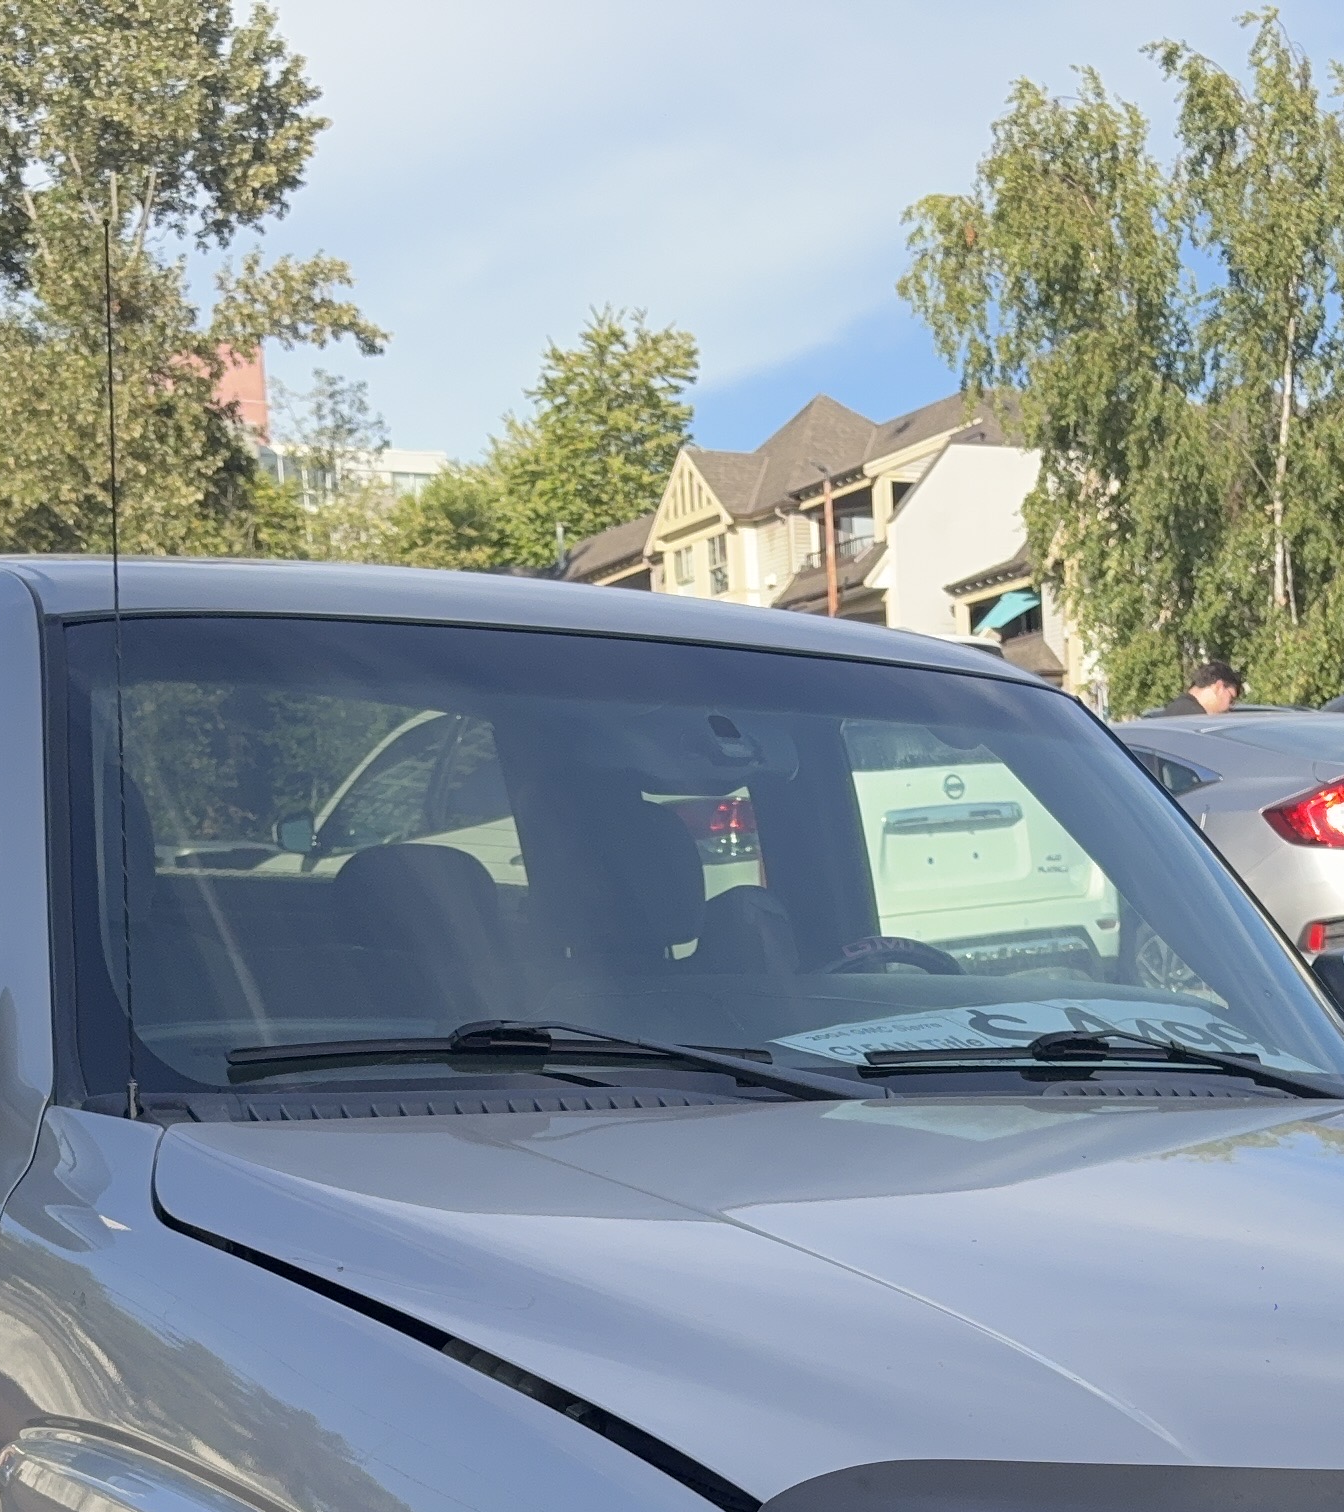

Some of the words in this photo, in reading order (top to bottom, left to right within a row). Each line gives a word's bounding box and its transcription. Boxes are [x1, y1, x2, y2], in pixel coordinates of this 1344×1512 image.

[855, 1025, 892, 1035] GMC
[892, 1021, 943, 1032] Sierra
[829, 1039, 916, 1056] CLEAN
[920, 1034, 986, 1051] Title
